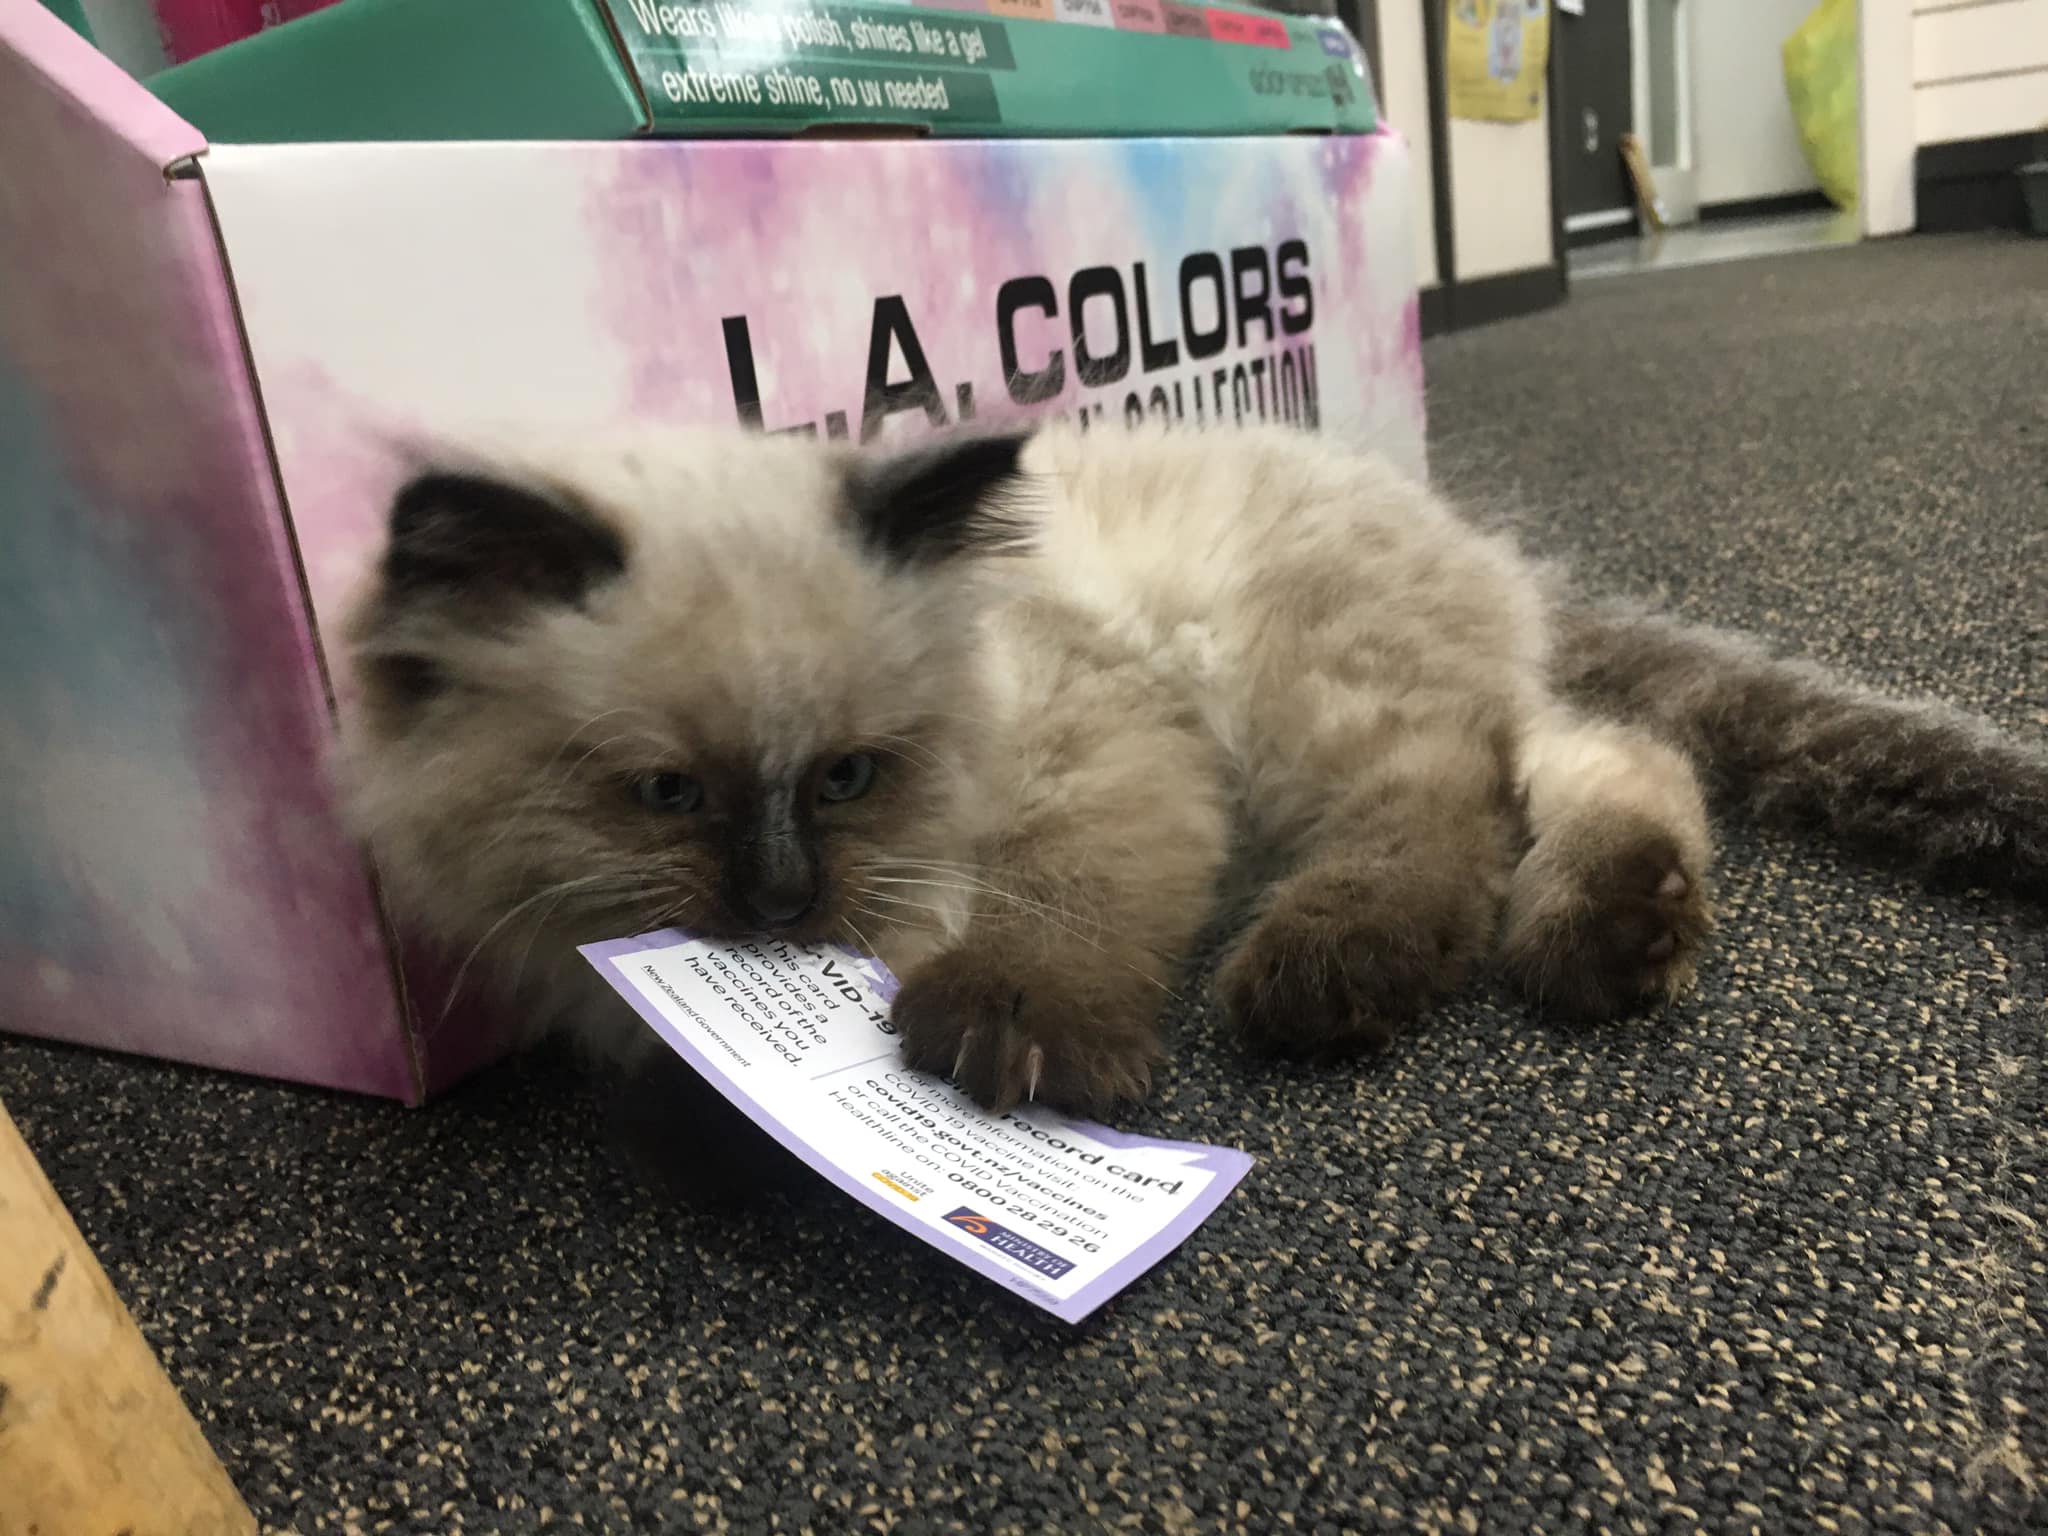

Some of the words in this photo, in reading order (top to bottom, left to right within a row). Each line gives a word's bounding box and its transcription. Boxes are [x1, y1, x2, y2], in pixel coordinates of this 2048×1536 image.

[633, 0, 716, 38] Wears
[853, 17, 911, 53] shines
[910, 20, 945, 55] like
[946, 29, 960, 57] a
[961, 26, 989, 64] gel
[661, 67, 760, 103] extreme
[764, 67, 831, 111] shine,
[831, 78, 856, 104] no
[858, 79, 882, 108] uv
[884, 75, 949, 110] needed
[721, 294, 976, 446] L.A.
[996, 239, 1315, 405] COLORS
[641, 964, 666, 985] New
[660, 983, 699, 1018] Zealand
[695, 1016, 751, 1068] Government
[684, 956, 726, 995] have
[724, 997, 799, 1067] received.
[706, 951, 775, 1020] vaccines
[774, 1021, 811, 1051] you
[724, 947, 783, 1001] record
[778, 1000, 803, 1020] of
[797, 1011, 828, 1046] the
[741, 943, 816, 1012] provides
[815, 1014, 829, 1025] a
[767, 938, 799, 972] This
[799, 974, 840, 1010] card
[806, 946, 898, 1036] VID-19
[828, 1090, 915, 1154] Healthline
[915, 1154, 945, 1173] on:
[947, 1172, 1007, 1206] 0800
[1006, 1204, 1038, 1222] 28
[1037, 1219, 1068, 1238] 29
[1068, 1235, 1101, 1254] 26
[847, 1085, 869, 1099] or
[867, 1101, 901, 1122] call
[898, 1122, 929, 1144] the
[931, 1143, 993, 1181] COVID
[995, 1179, 1110, 1240] Vaccination
[866, 1079, 1109, 1221] covid19.govt.nz/vaccines
[884, 1073, 966, 1129] COVID-19
[966, 1128, 1035, 1169] vaccine
[1038, 1167, 1080, 1192] visit:
[928, 1089, 974, 1119] more
[975, 1118, 1080, 1176] information
[1082, 1173, 1107, 1189] on
[1111, 1184, 1145, 1203] the
[1000, 1113, 1104, 1166] record
[1106, 1164, 1184, 1195] card
[881, 1168, 928, 1198] against
[899, 1170, 935, 1194] Unite
[989, 1235, 1063, 1276] HEALTH
[998, 1231, 1053, 1262] MINISTRY
